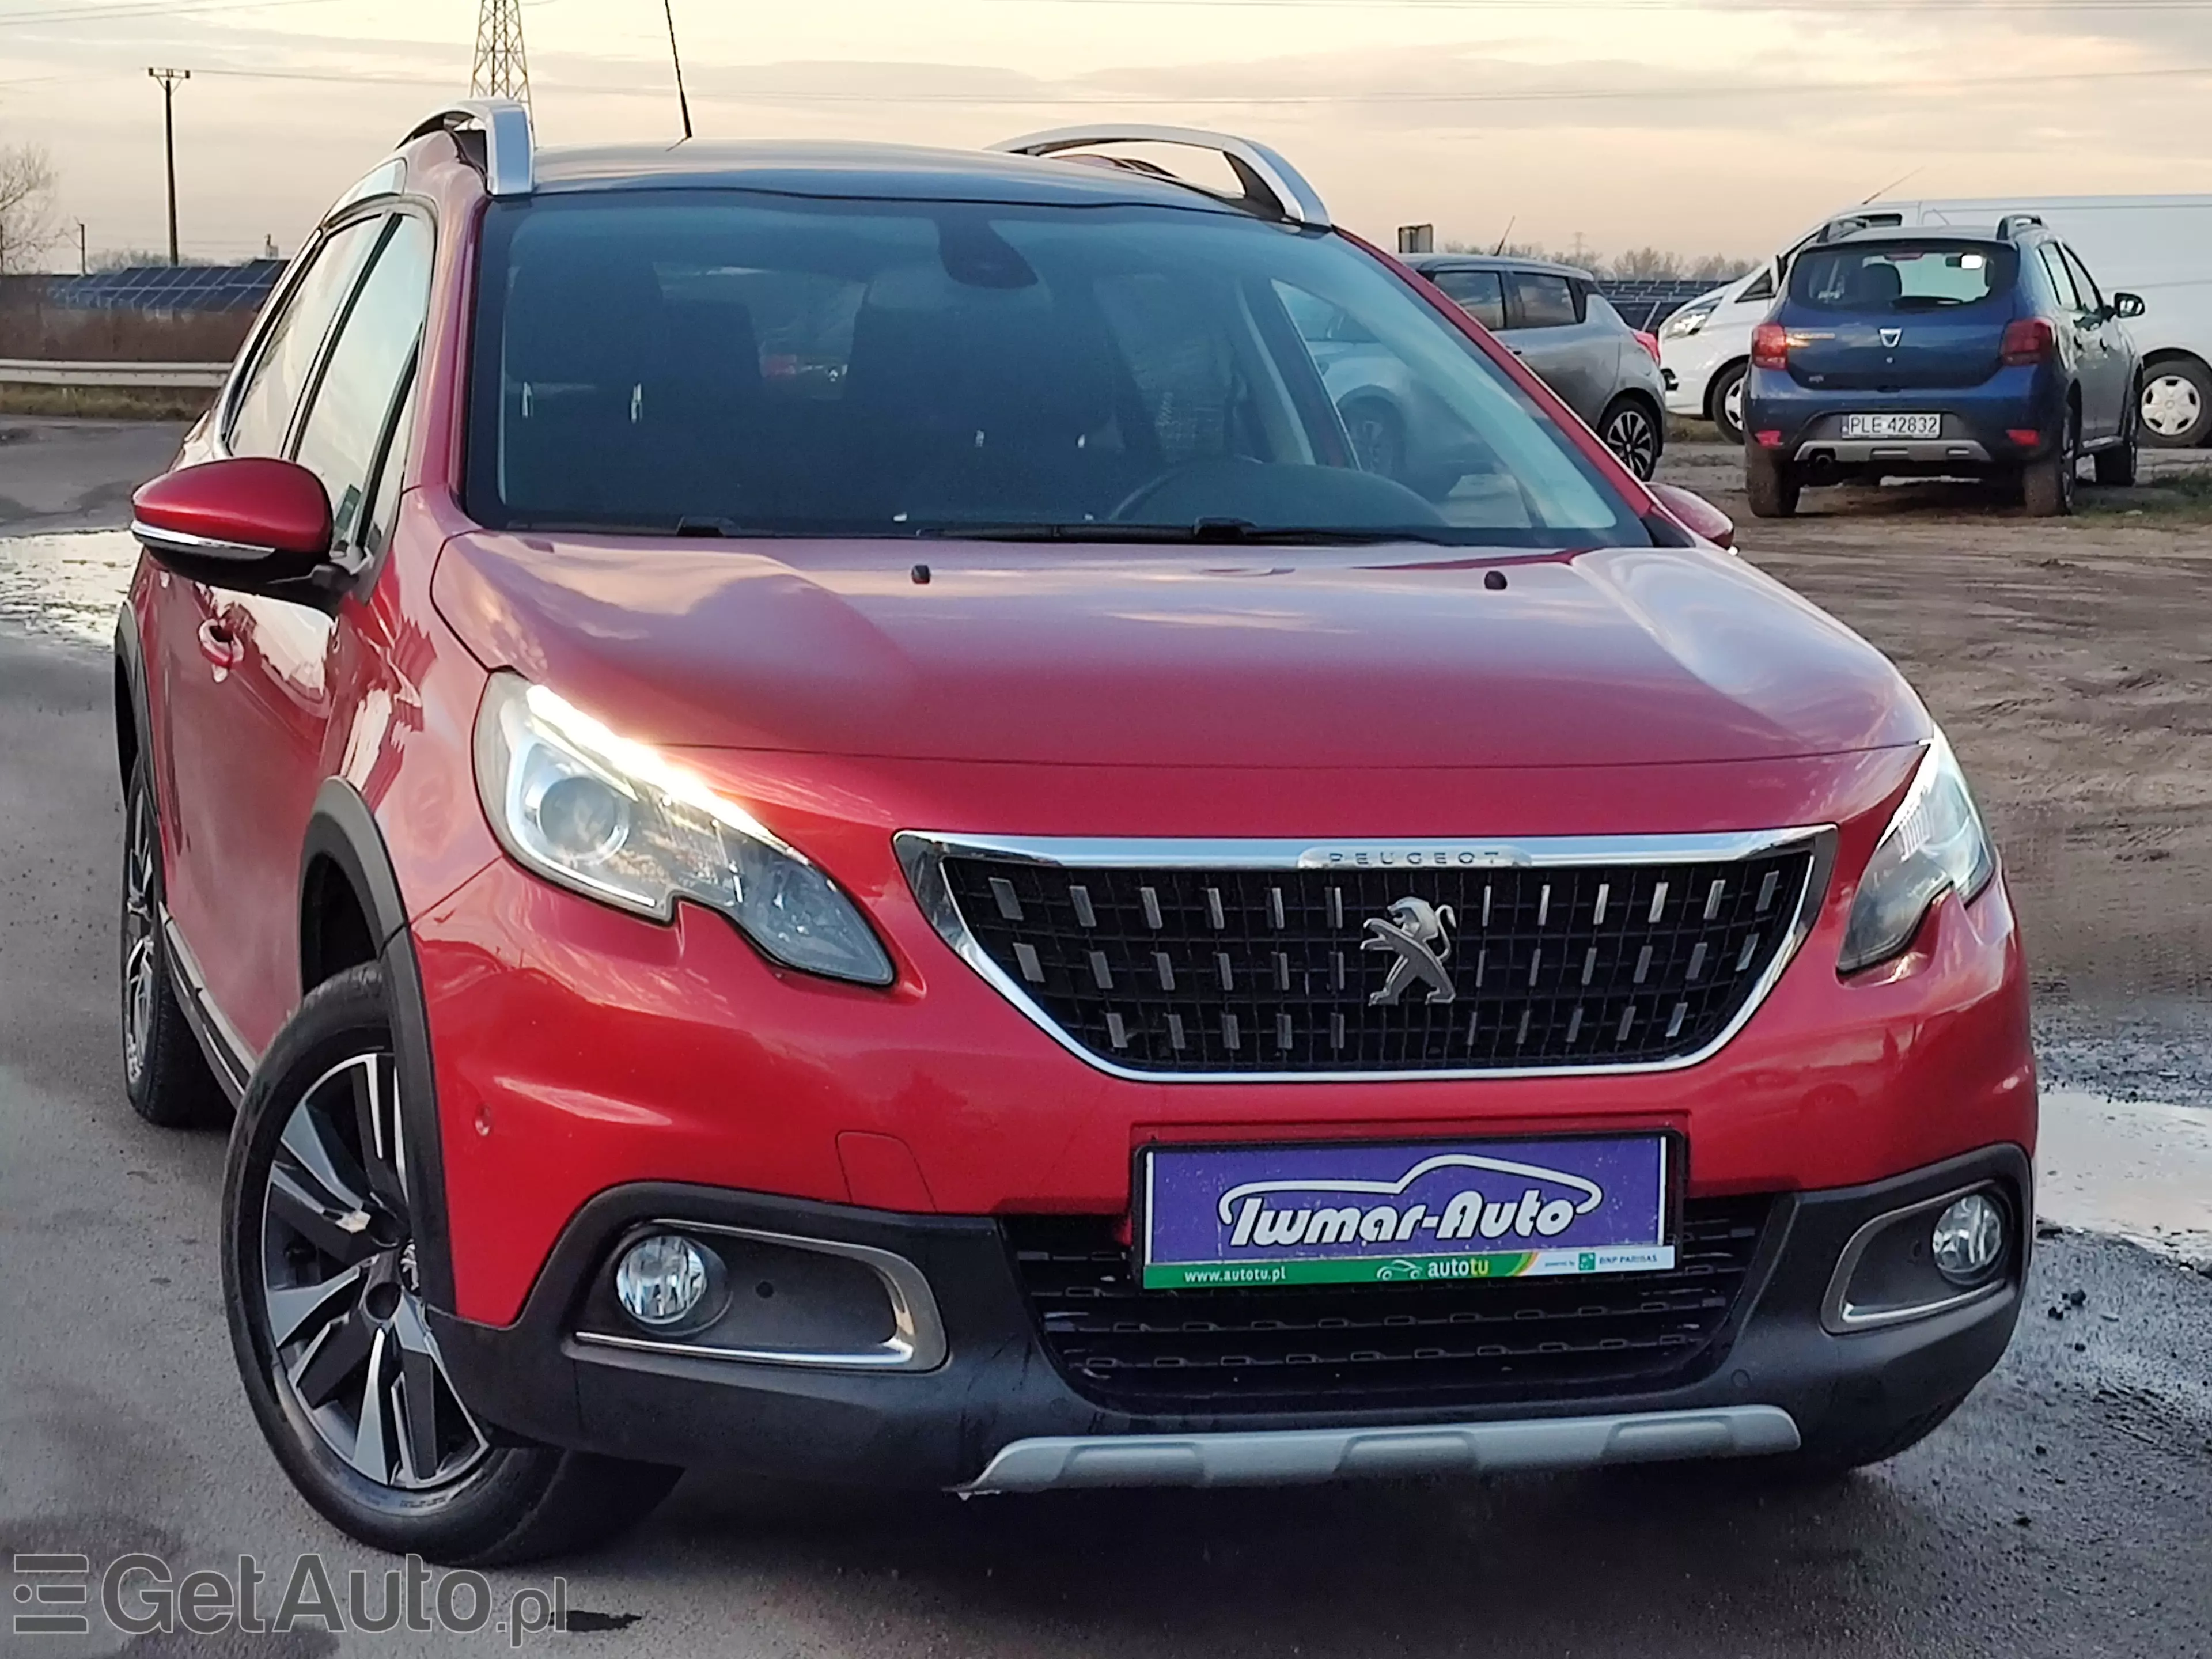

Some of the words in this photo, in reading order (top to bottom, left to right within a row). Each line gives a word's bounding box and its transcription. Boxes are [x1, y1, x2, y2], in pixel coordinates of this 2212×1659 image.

[1851, 416, 1883, 433] PLE
[1888, 416, 1937, 433] 42832
[1329, 851, 1499, 865] PEUGEOT
[1230, 1190, 1577, 1247] Iwmar-Auto
[1184, 1267, 1286, 1283] www.autotu.pl
[1427, 1257, 1489, 1278] autotu
